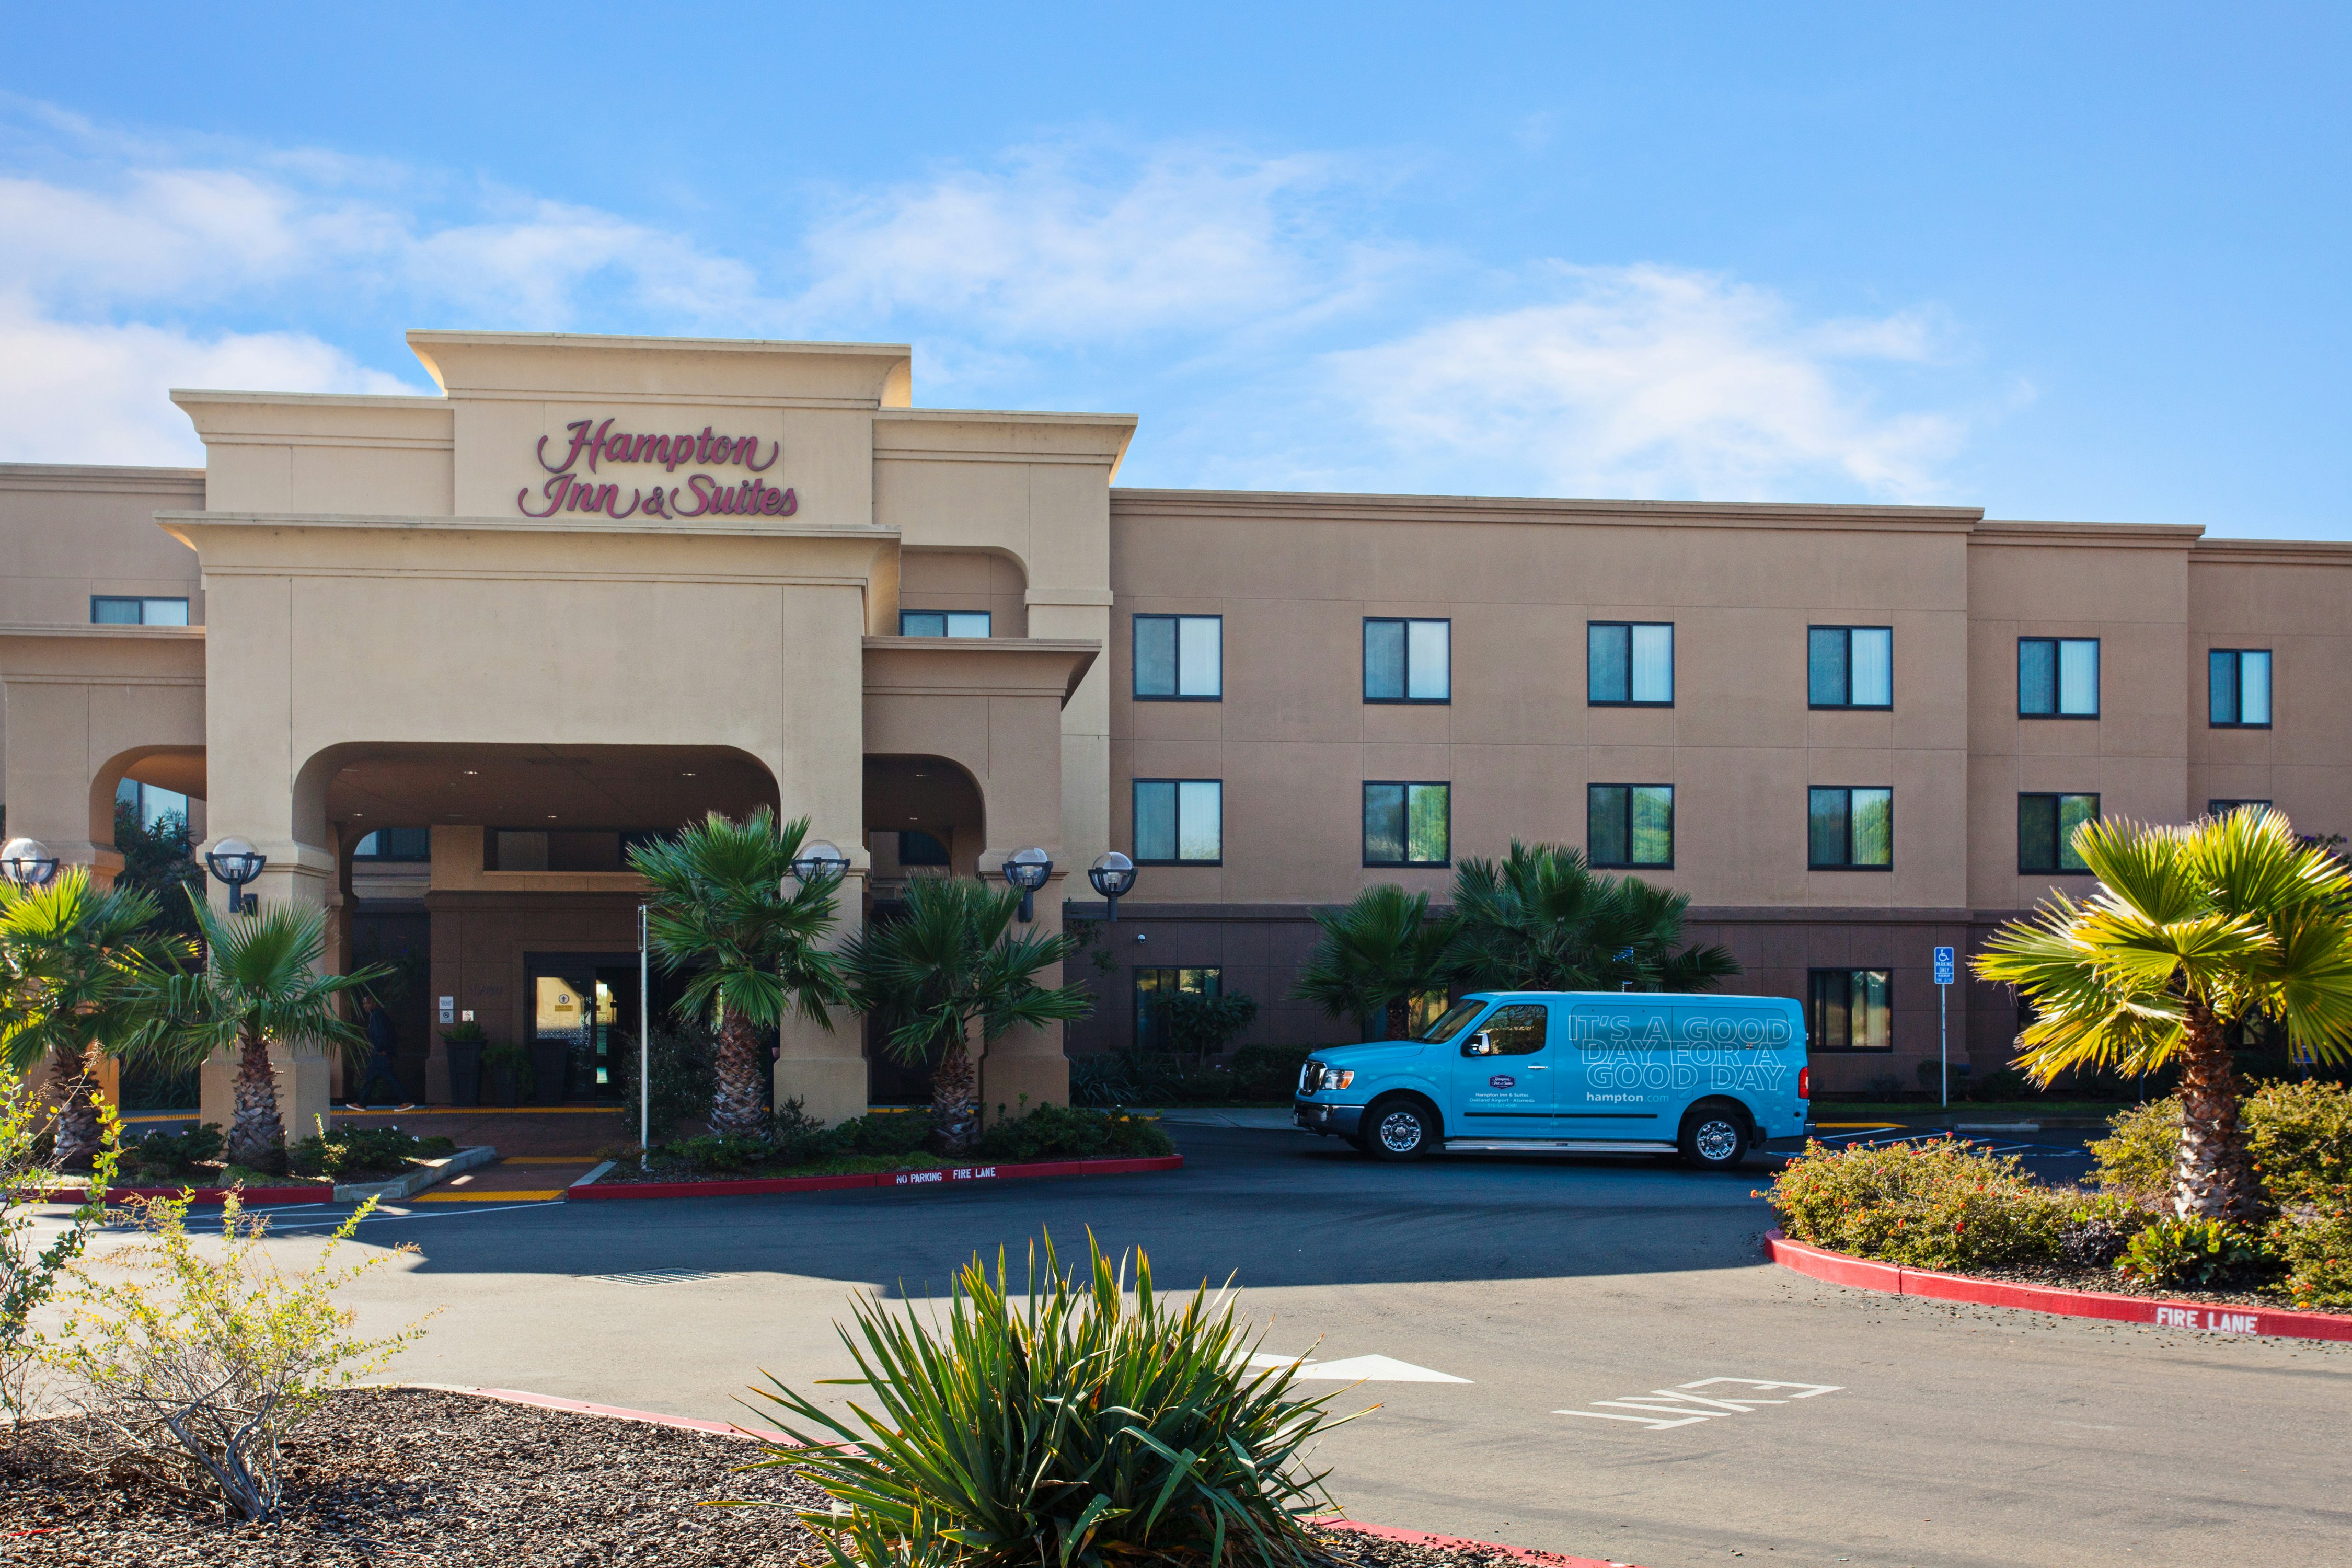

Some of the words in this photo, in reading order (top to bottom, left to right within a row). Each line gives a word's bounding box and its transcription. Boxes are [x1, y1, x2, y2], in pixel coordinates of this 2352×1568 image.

[537, 418, 779, 474] Hampton
[518, 473, 640, 519] Inn
[641, 486, 673, 520] &
[670, 474, 798, 517] Suites
[1569, 1014, 1631, 1041] IT'S
[1642, 1016, 1671, 1042] A
[1682, 1017, 1792, 1044] GOOD
[1582, 1039, 1658, 1065] DAY
[1670, 1040, 1742, 1067] FOR
[1752, 1042, 1782, 1067] A
[1587, 1063, 1698, 1089] GOOD
[1711, 1064, 1787, 1091] DAY
[1586, 1092, 1669, 1103] hampton.com
[896, 1175, 907, 1184] NO
[910, 1172, 942, 1183] PARKING
[953, 1169, 972, 1179] FIRE
[975, 1167, 996, 1178] LANE
[2157, 1307, 2199, 1329] FIRE
[2208, 1312, 2258, 1334] LANE
[1550, 1377, 1846, 1430] EXIT
